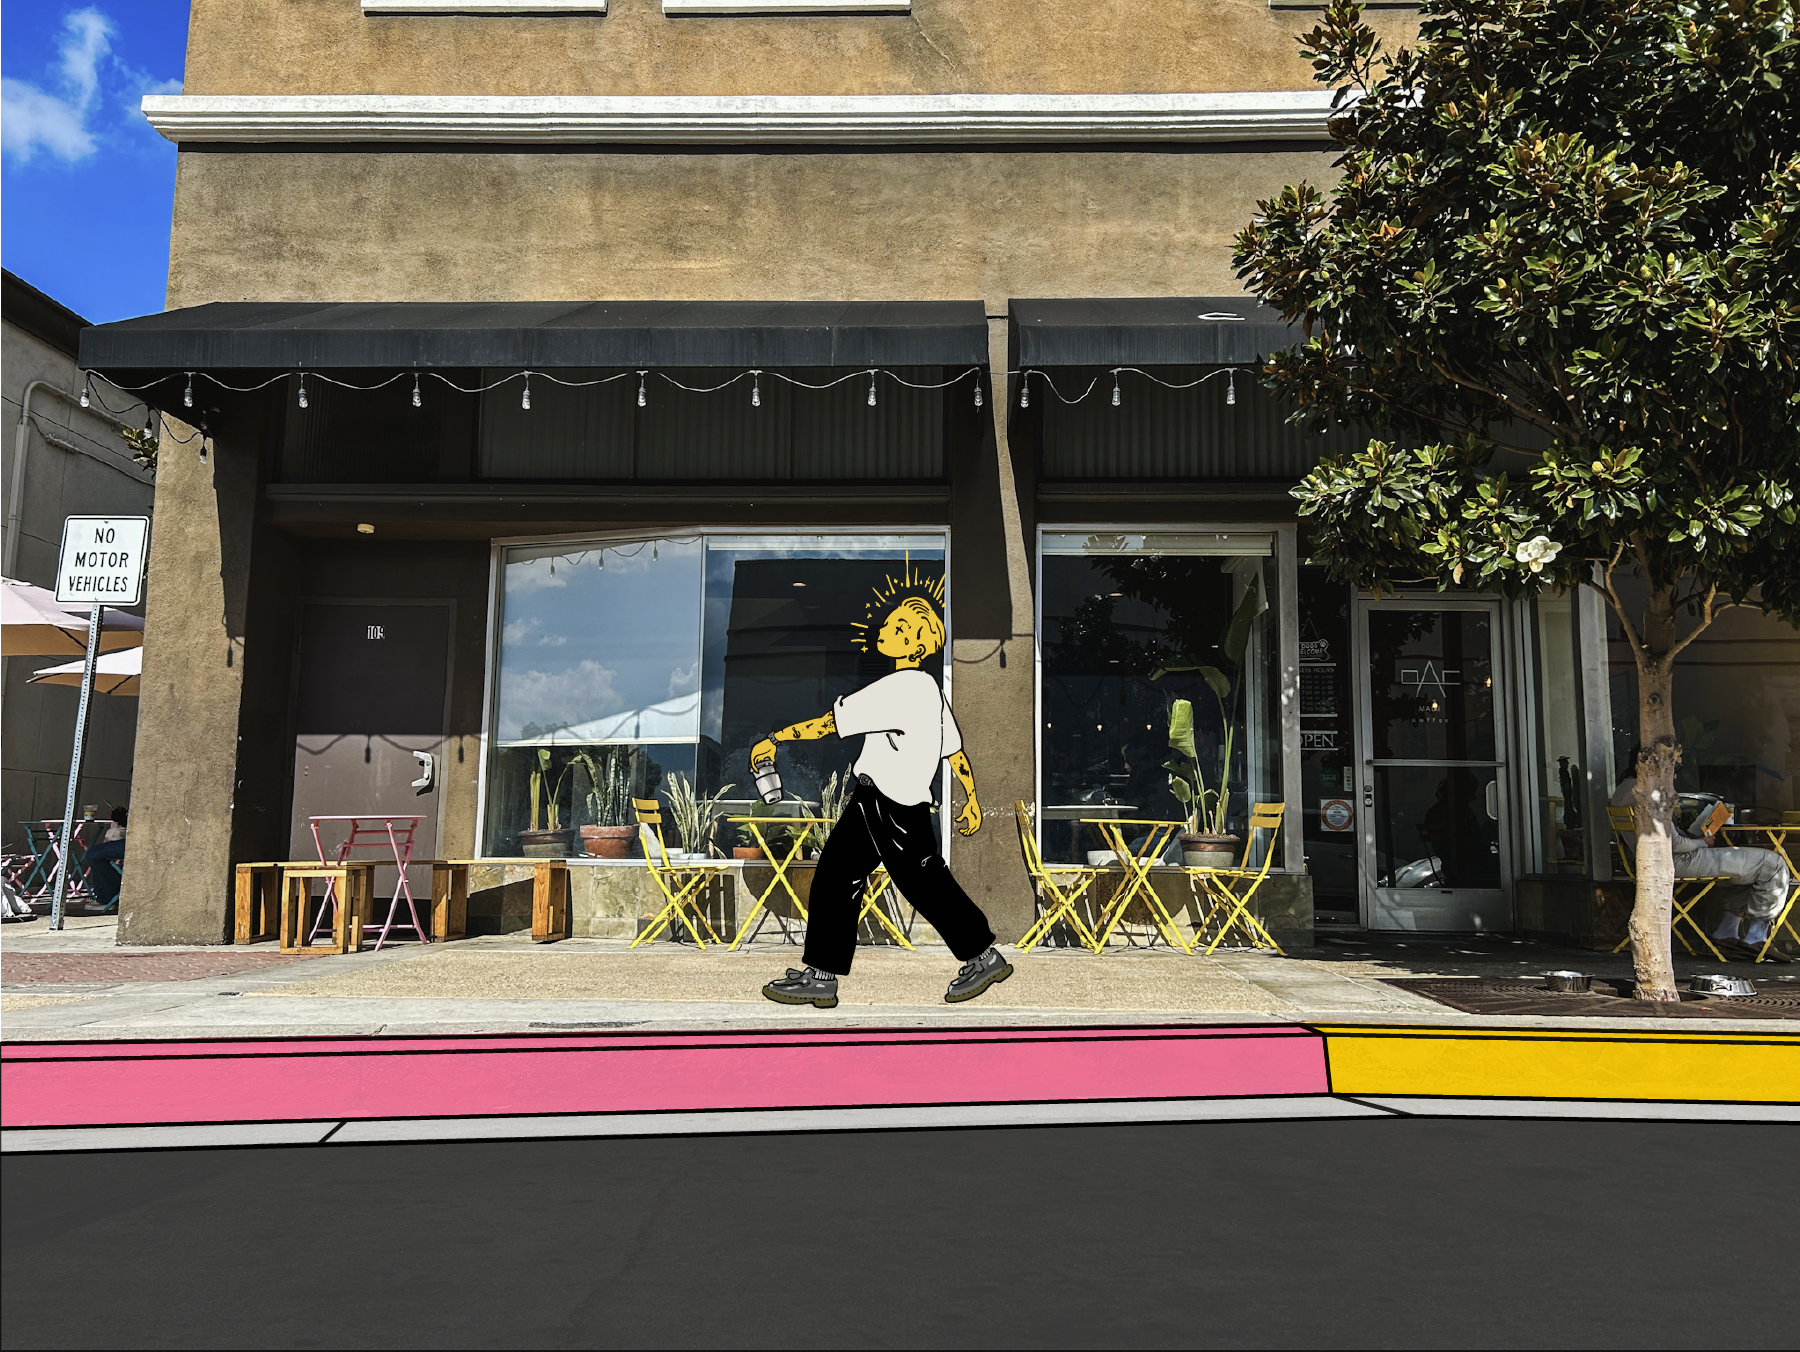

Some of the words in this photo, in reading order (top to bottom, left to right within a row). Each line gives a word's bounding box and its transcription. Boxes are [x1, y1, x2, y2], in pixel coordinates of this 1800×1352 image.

[94, 528, 115, 544] NO
[75, 552, 129, 568] MOTOR
[69, 576, 128, 592] VEHICLES
[368, 626, 385, 639] 109
